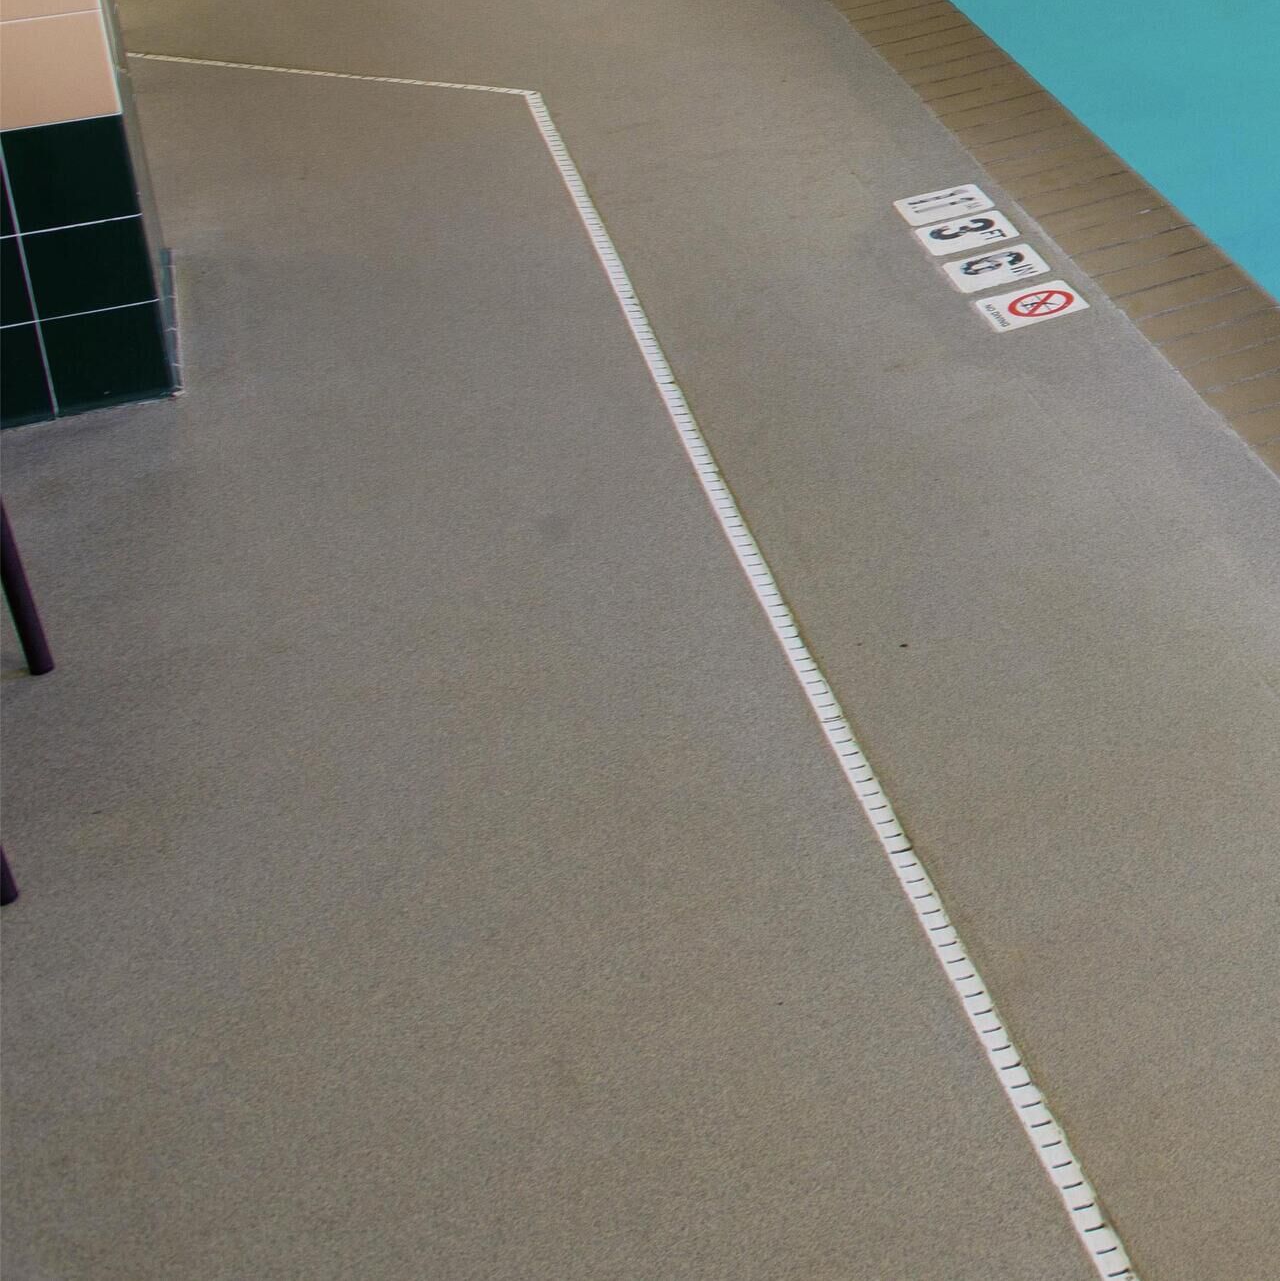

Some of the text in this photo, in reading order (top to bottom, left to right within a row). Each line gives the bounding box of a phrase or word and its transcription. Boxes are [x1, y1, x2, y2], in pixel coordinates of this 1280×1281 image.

[929, 218, 1007, 240] 3 FT
[960, 251, 1039, 278] 6 IN
